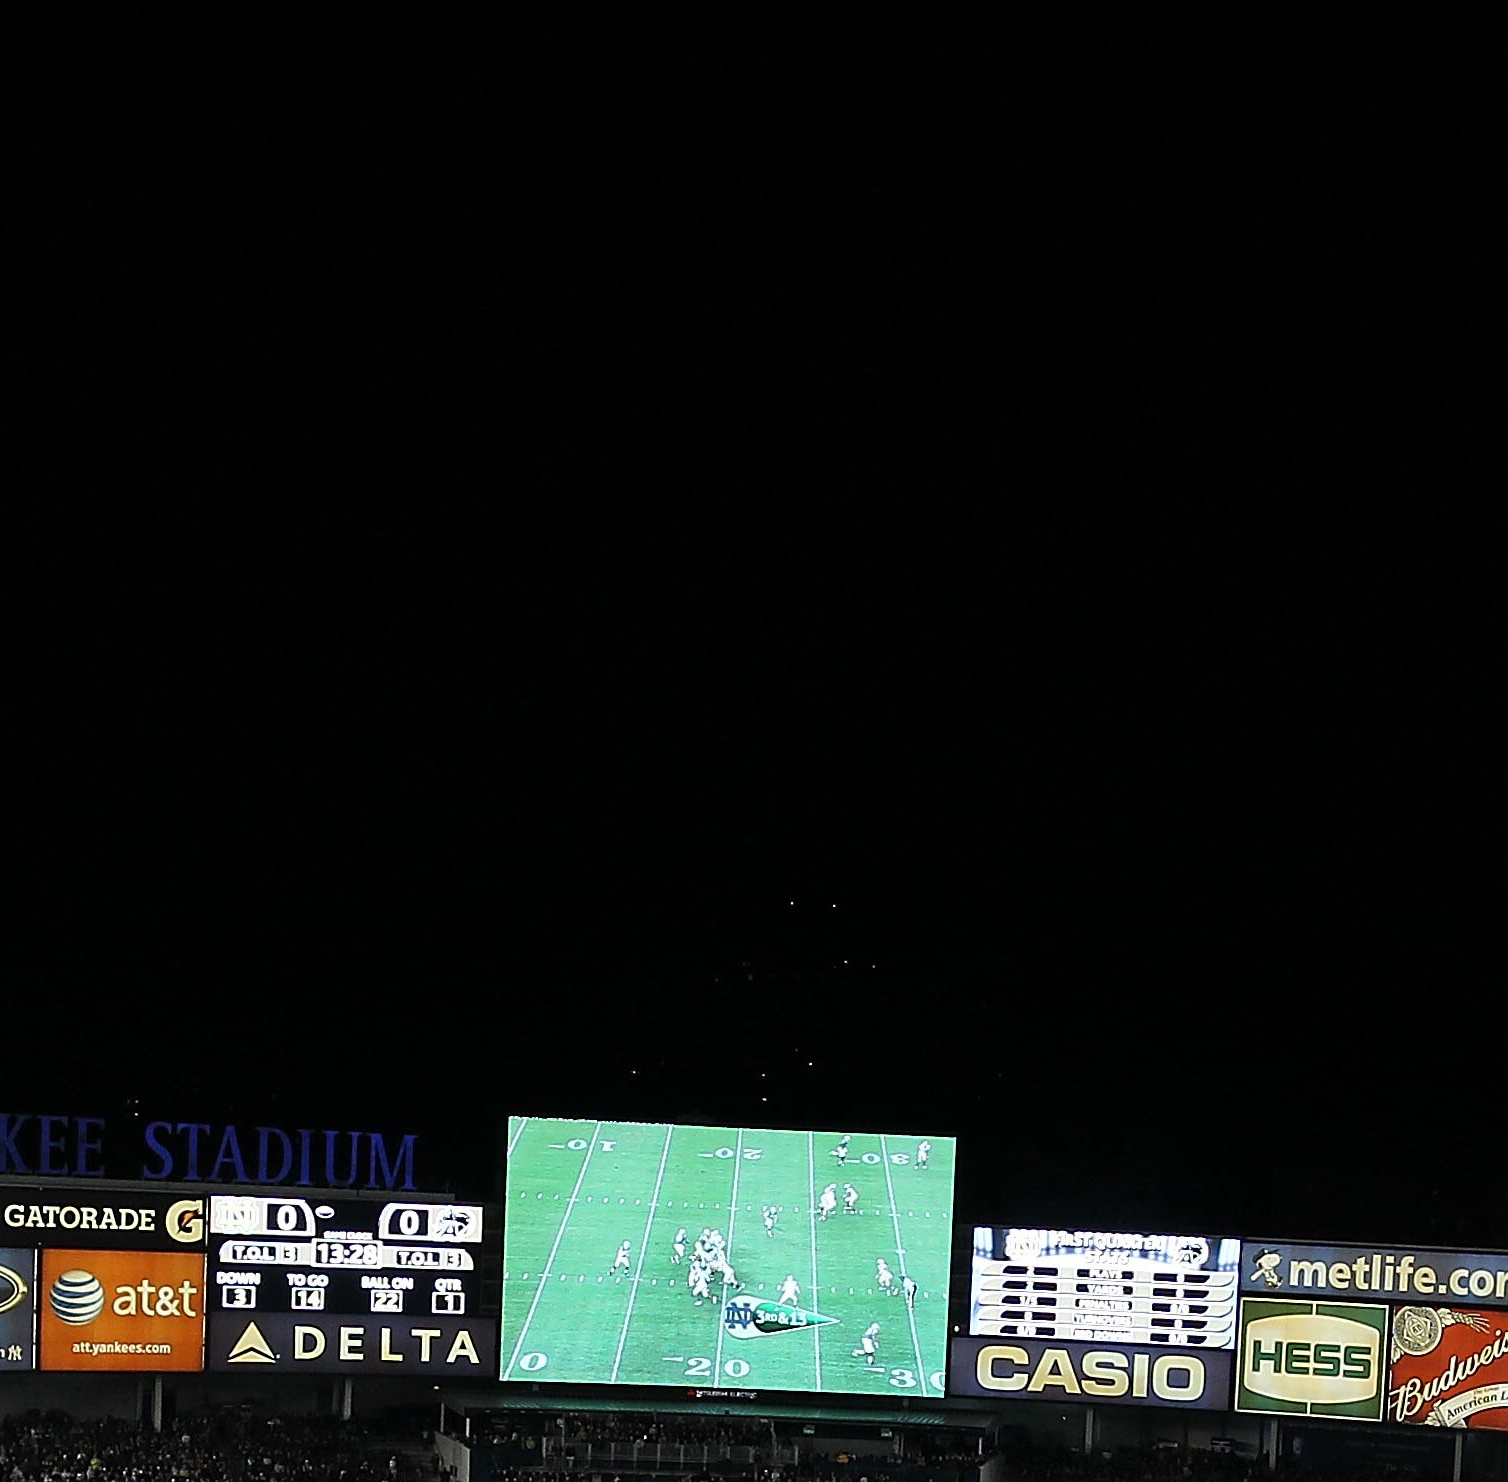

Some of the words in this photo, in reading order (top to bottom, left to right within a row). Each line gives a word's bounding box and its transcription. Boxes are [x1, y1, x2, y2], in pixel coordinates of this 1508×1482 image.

[143, 1120, 419, 1190] STADIUM
[4, 1204, 156, 1231] GATORADE
[165, 1200, 203, 1243] G
[277, 1205, 297, 1231] 0
[399, 1210, 420, 1235] 0
[1054, 1231, 1091, 1249] FIRST
[317, 1244, 378, 1264] 13:28
[1085, 1250, 1129, 1265] STATS
[216, 1272, 260, 1285] DOWN
[287, 1274, 305, 1286] TO
[307, 1275, 328, 1287] GO
[391, 1278, 413, 1289] ON
[113, 1279, 197, 1318] at&t
[233, 1289, 246, 1305] 3
[297, 1291, 321, 1307] 14
[375, 1293, 399, 1310] 22
[444, 1296, 454, 1311] 1
[72, 1342, 171, 1356] att.yankees.com
[294, 1325, 480, 1364] DELTA
[1252, 1340, 1372, 1379] HESS
[976, 1346, 1205, 1400] CASIO
[1447, 1393, 1498, 1420] American
